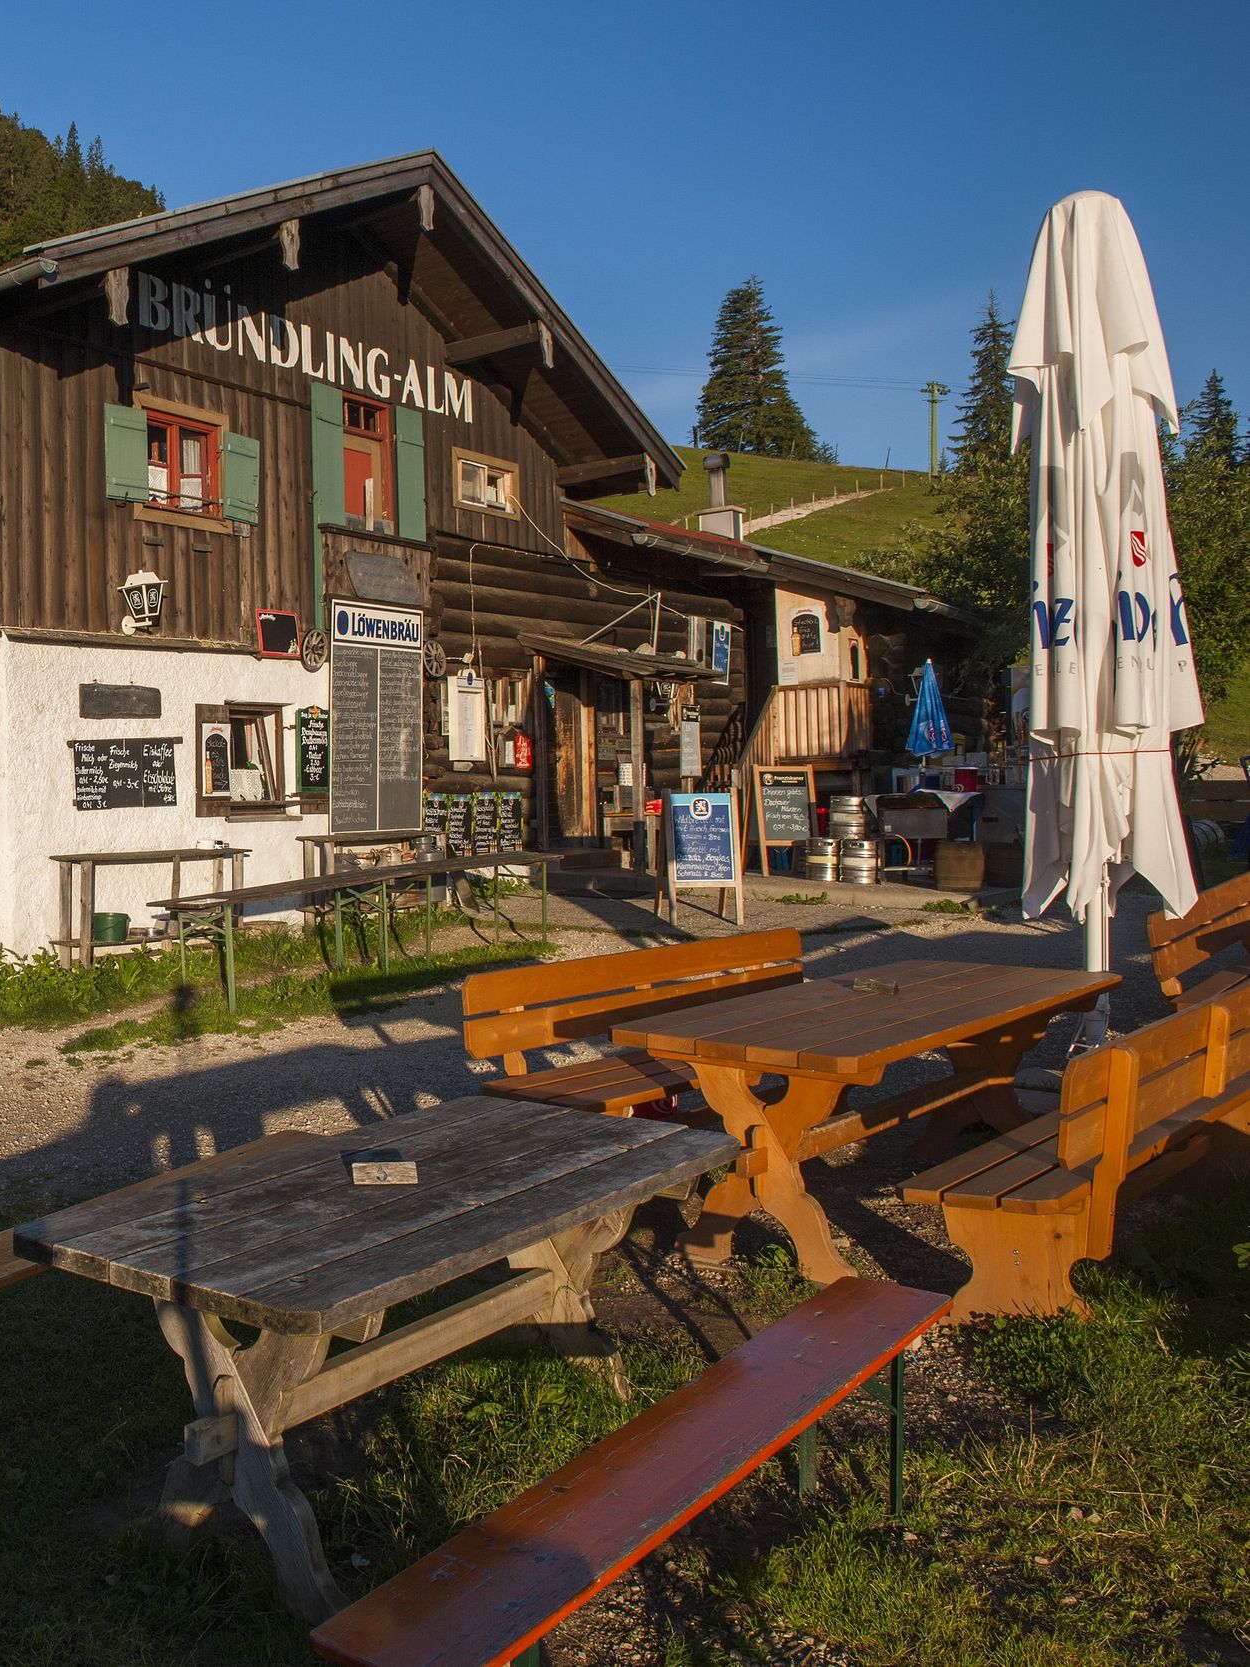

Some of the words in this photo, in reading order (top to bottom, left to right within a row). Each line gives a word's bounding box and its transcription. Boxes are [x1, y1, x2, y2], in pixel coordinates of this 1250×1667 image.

[351, 611, 419, 643] LÖWENBRÄU
[74, 742, 95, 752] Frische
[110, 745, 130, 757] Frische
[143, 743, 173, 761] Eiskaffee
[81, 753, 94, 765] Milch
[97, 753, 108, 762] oder
[152, 760, 164, 768] oder
[108, 759, 138, 772] Ziegenmilch
